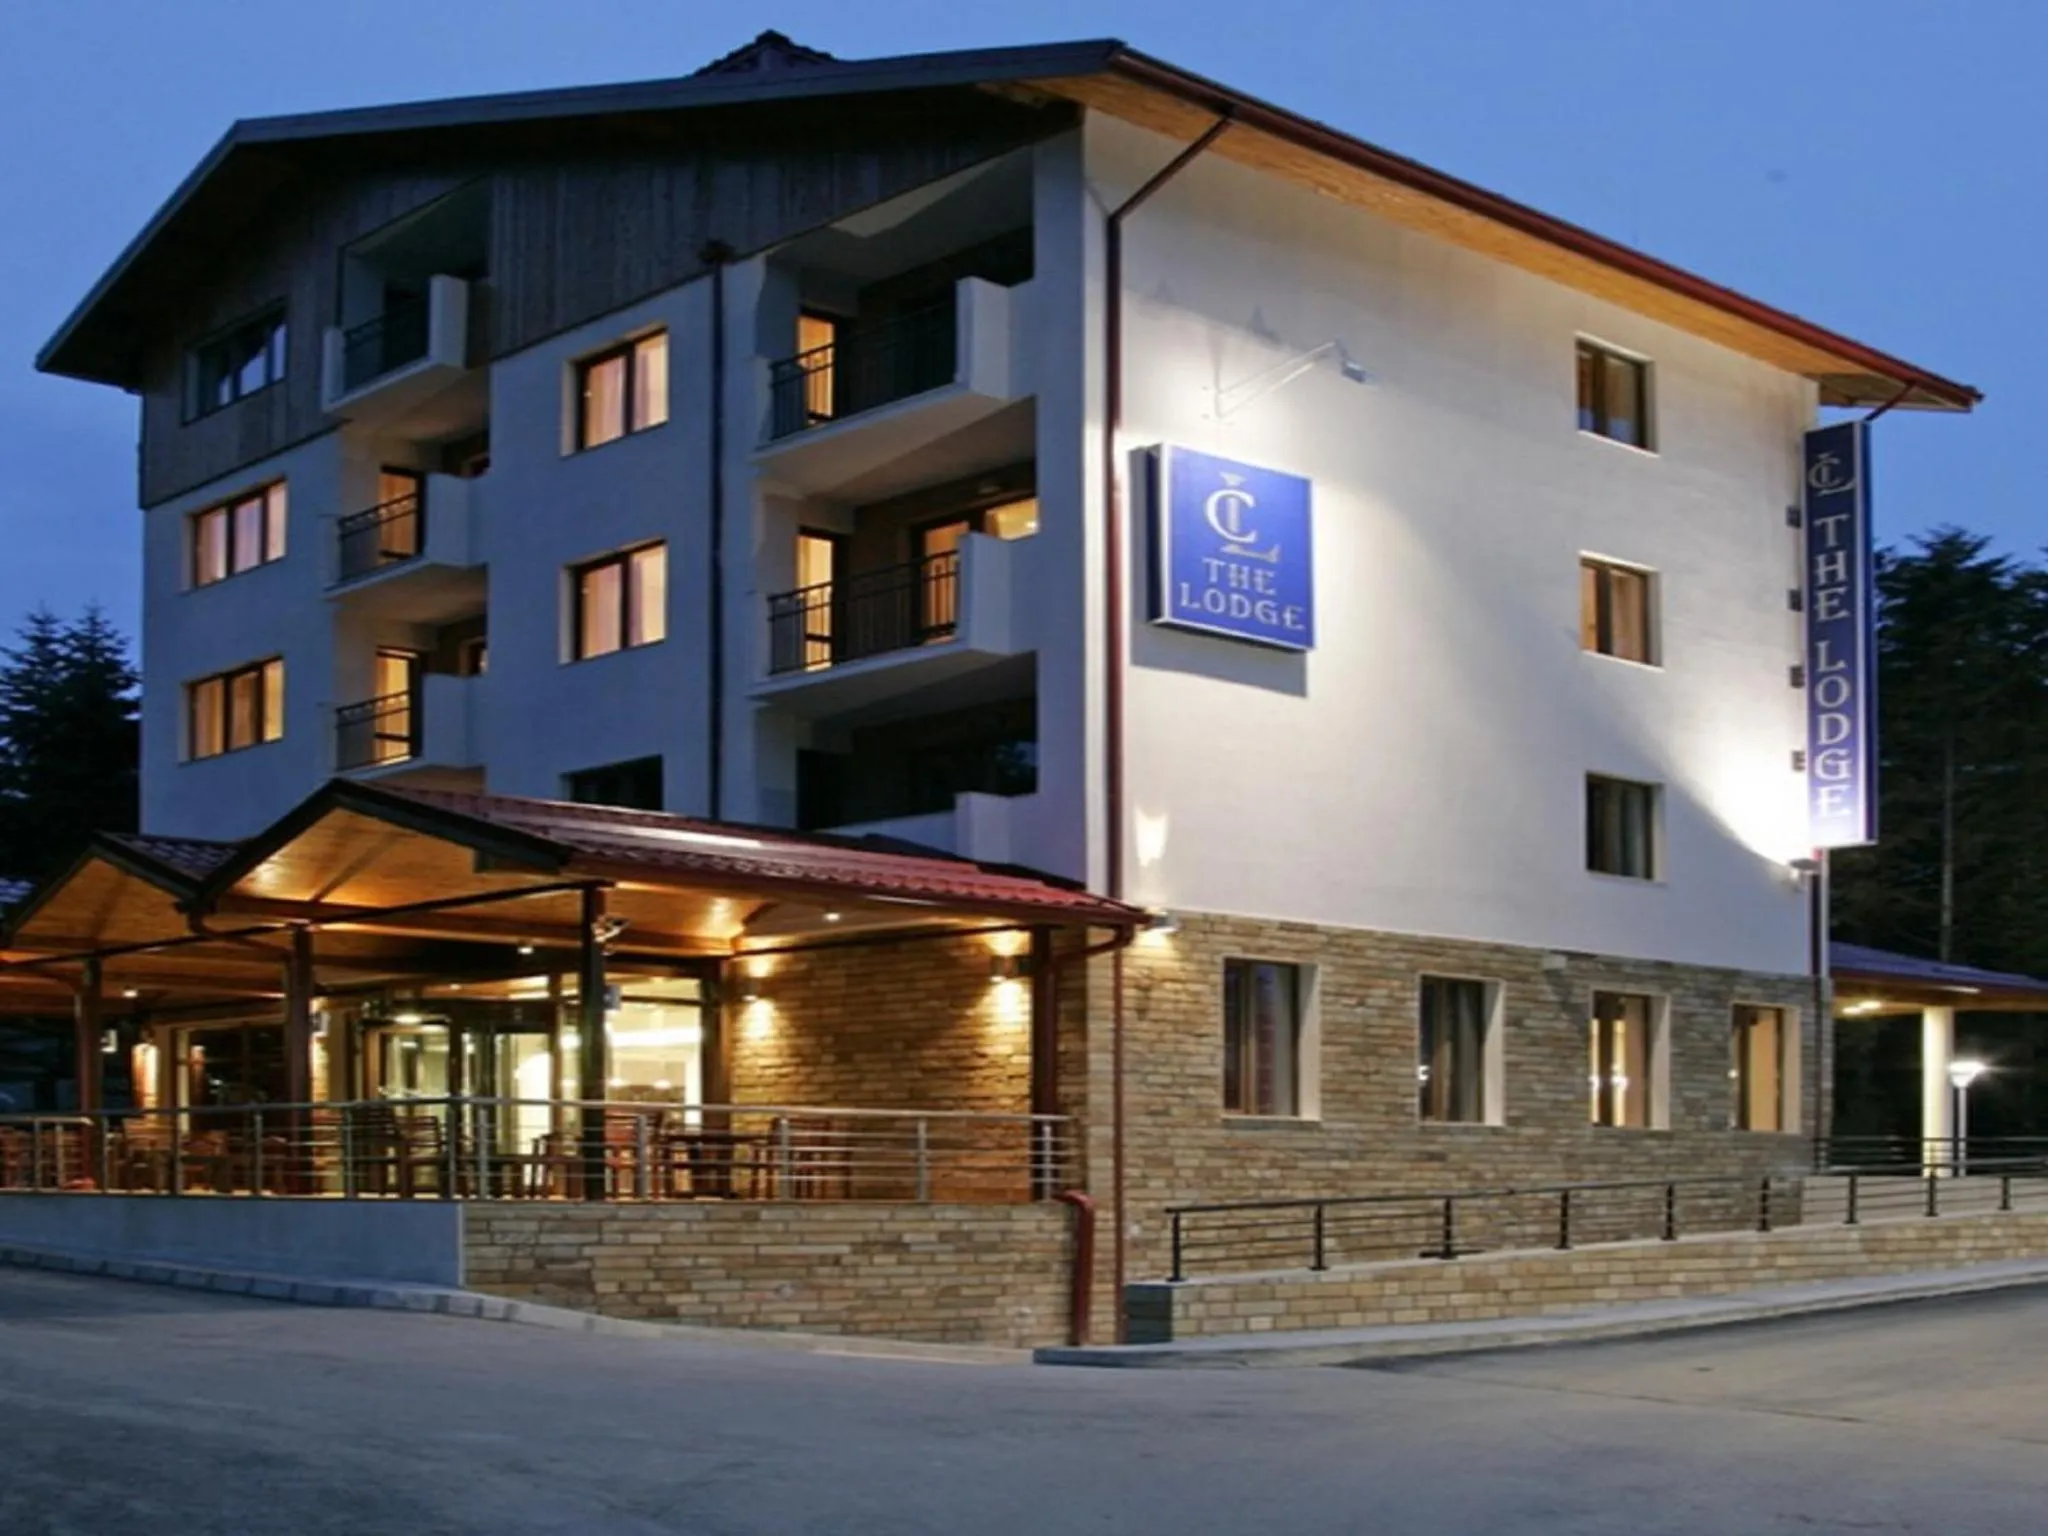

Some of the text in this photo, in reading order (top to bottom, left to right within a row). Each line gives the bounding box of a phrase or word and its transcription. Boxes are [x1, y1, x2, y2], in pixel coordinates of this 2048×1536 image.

[1204, 558, 1276, 594] THE
[1181, 582, 1305, 629] LODGE
[1814, 514, 1851, 816] THE LODGE
